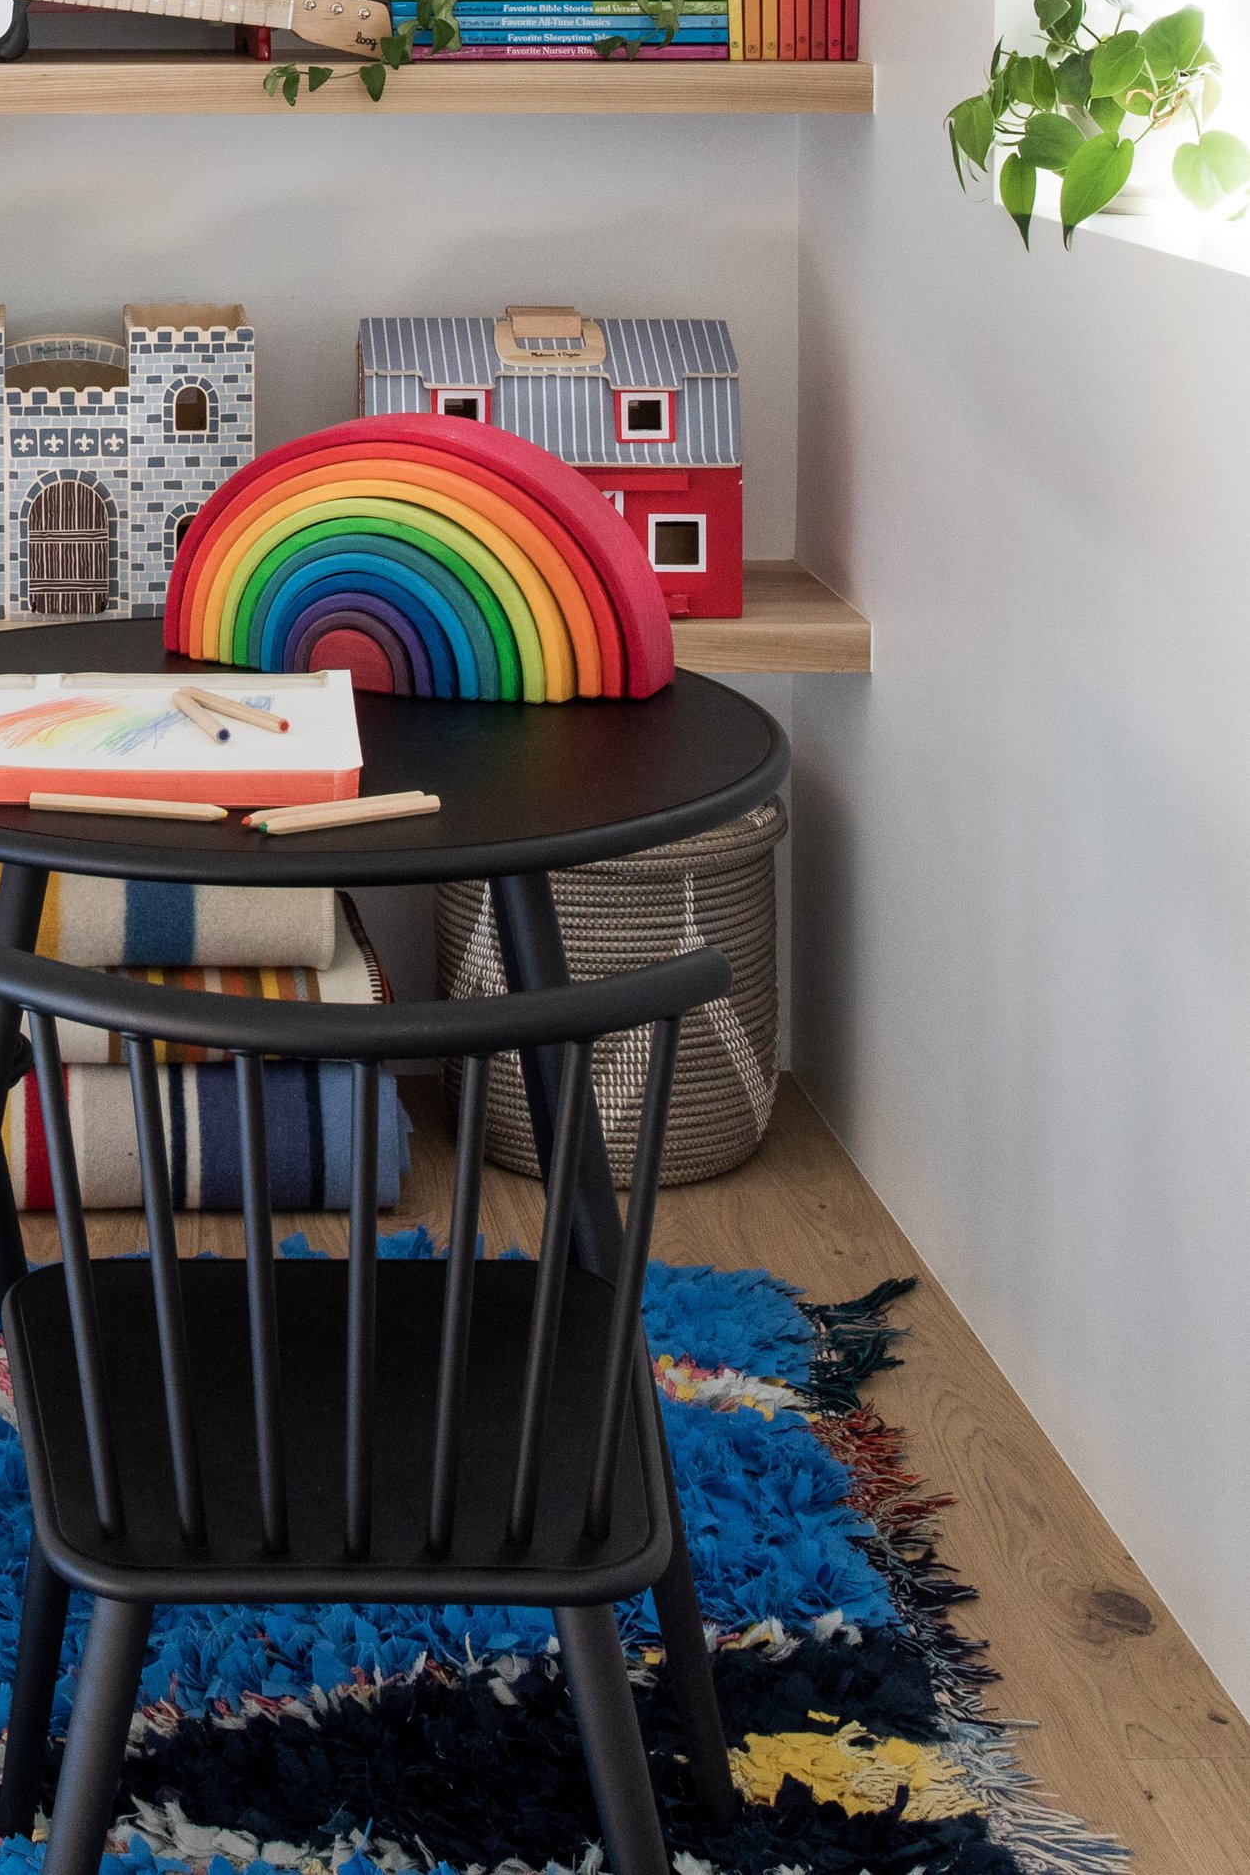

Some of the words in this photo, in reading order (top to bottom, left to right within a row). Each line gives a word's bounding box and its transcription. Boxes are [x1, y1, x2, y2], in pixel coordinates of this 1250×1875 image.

[563, 4, 593, 12] Stories
[539, 17, 574, 25] All-Time
[576, 17, 610, 26] Classics
[355, 32, 378, 51] loog
[544, 34, 592, 43] Sleepytime
[542, 47, 576, 56] Nursery
